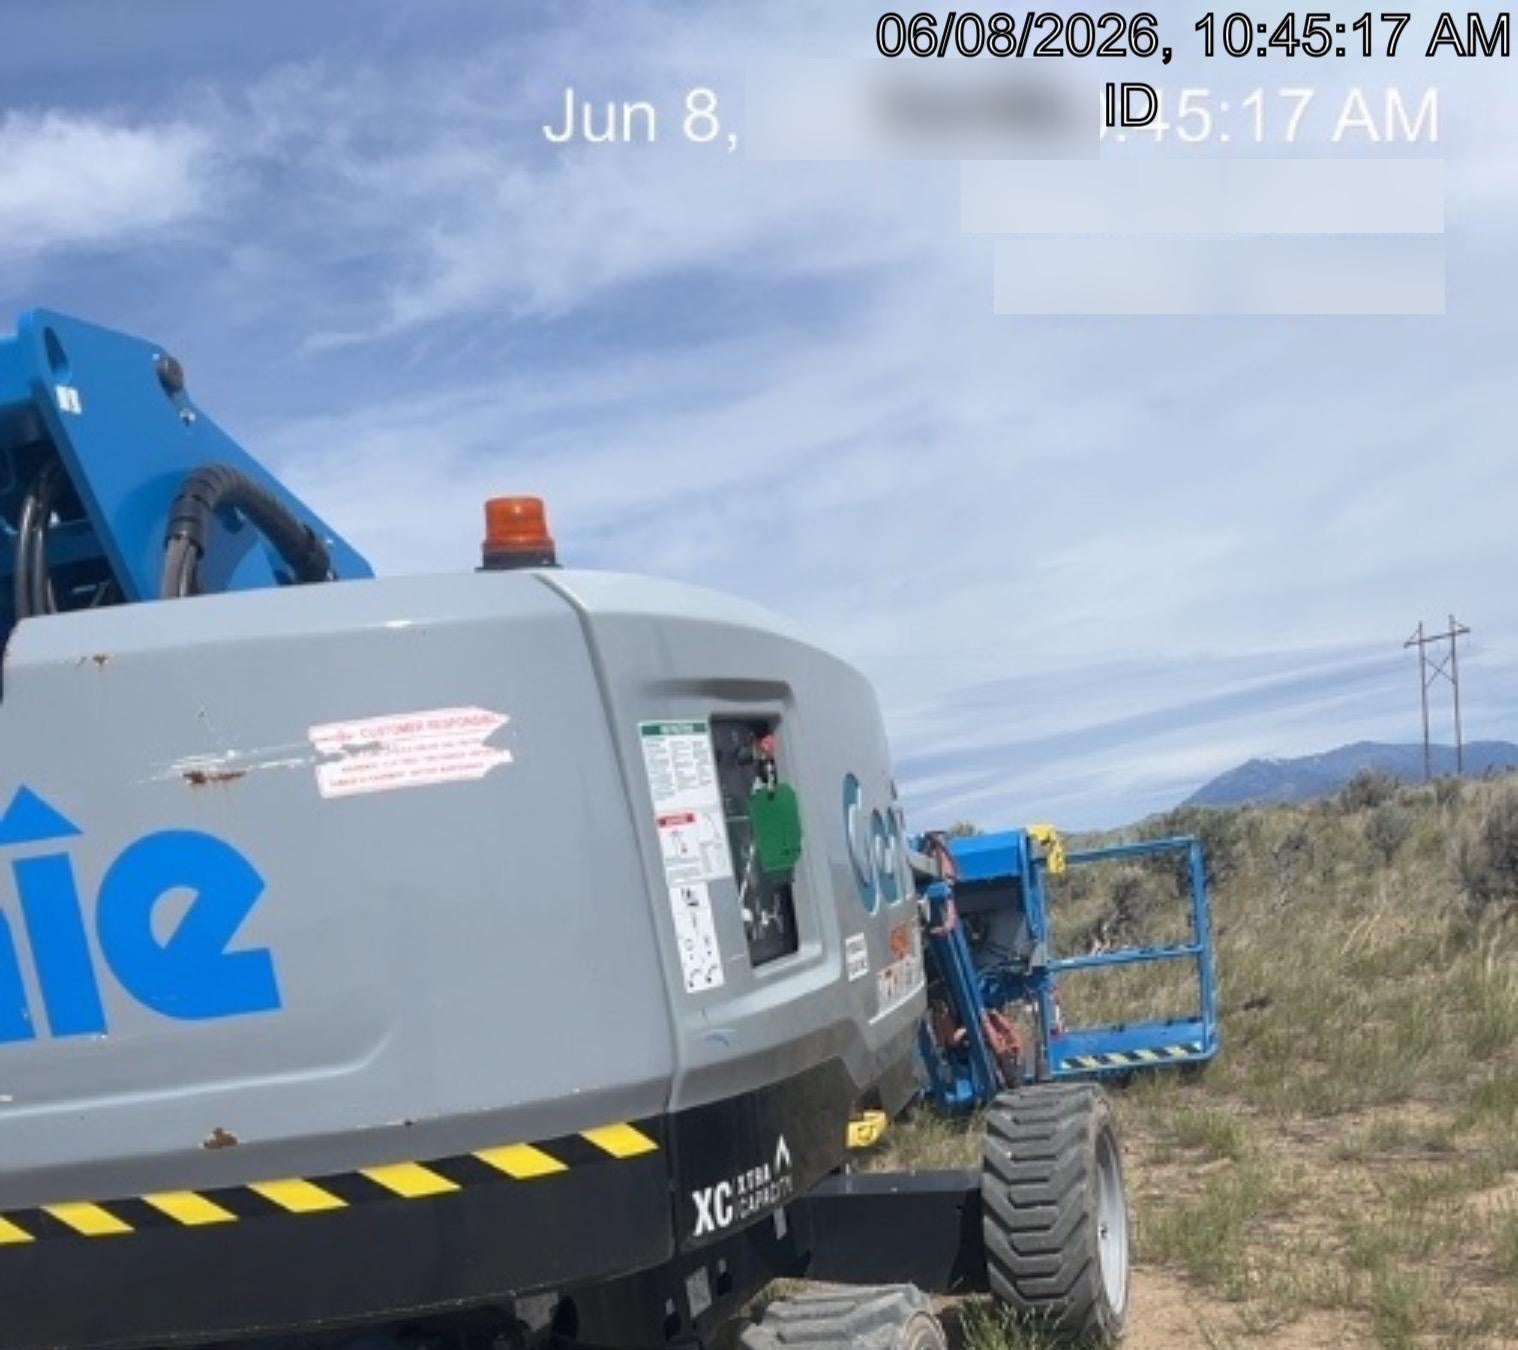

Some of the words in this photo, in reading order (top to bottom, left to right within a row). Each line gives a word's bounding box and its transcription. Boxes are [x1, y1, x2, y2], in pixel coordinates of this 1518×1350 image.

[359, 720, 424, 739] CUSTOMER
[736, 1163, 772, 1195] XTRA
[692, 1180, 734, 1237] XC
